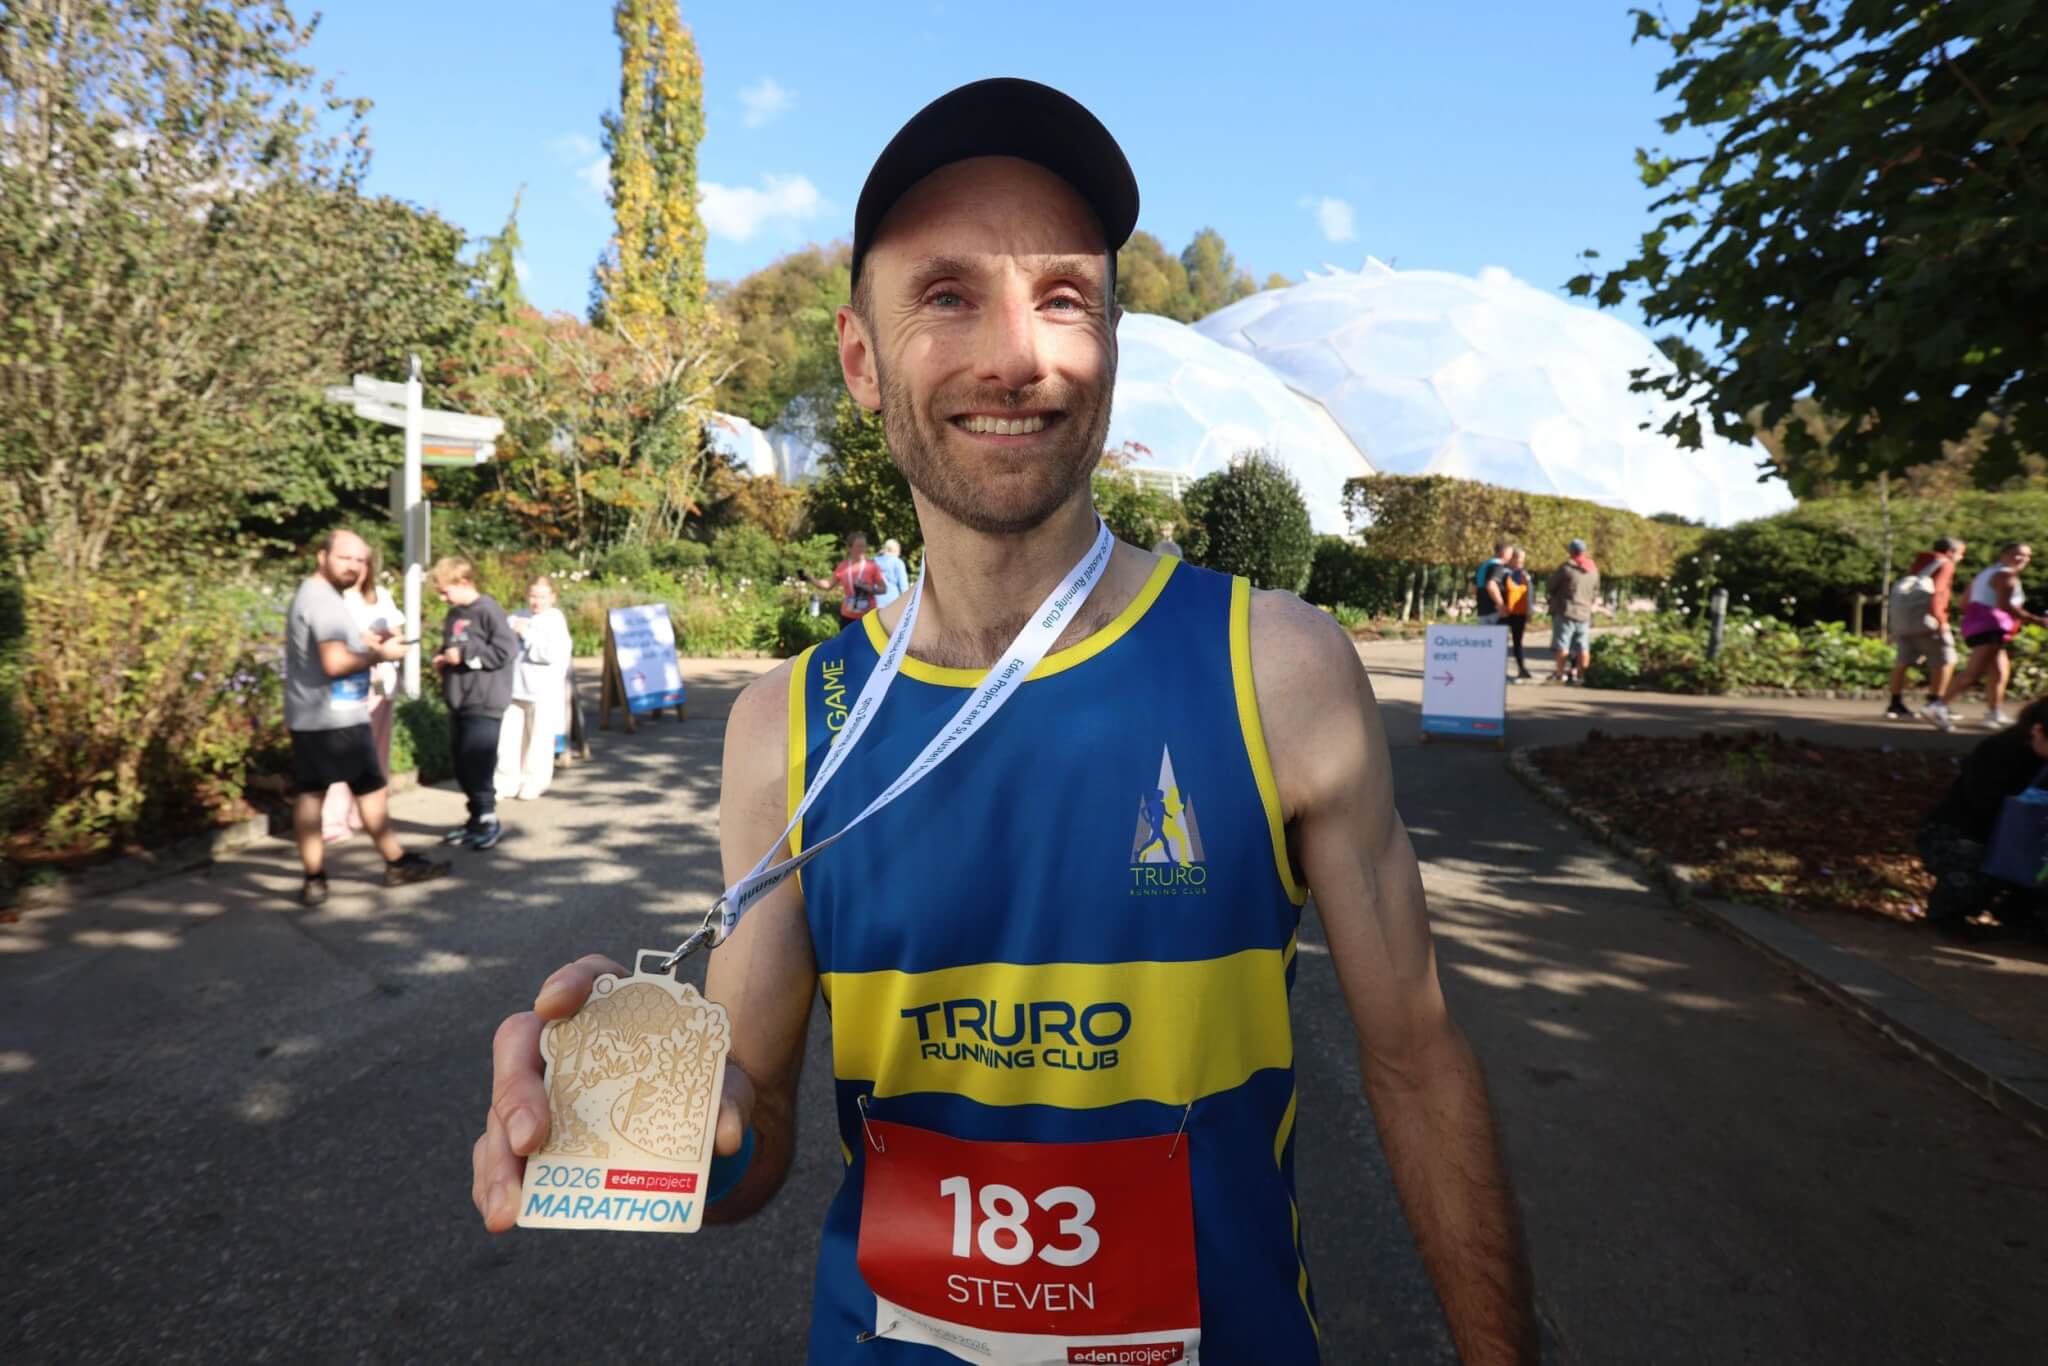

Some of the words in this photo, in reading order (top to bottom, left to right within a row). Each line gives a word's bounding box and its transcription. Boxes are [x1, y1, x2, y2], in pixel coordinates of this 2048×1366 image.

[1055, 575, 1087, 612] Running
[1042, 609, 1060, 629] Club
[1434, 635, 1492, 648] Quickest
[1433, 651, 1457, 661] exit
[1001, 658, 1024, 679] Eden
[980, 679, 1007, 709] Project
[963, 709, 980, 726] and
[952, 726, 967, 736] St
[1130, 866, 1206, 886] TRURO
[900, 998, 1131, 1046] TRURO
[921, 1041, 1035, 1069] RUNNING
[1042, 1048, 1119, 1071] CLUB
[534, 1164, 601, 1189] 2026
[611, 1173, 645, 1185] eden
[645, 1175, 692, 1189] project
[525, 1193, 693, 1223] MARATHON
[940, 1175, 1100, 1267] 183
[947, 1274, 1095, 1311] STEVEN
[1074, 1350, 1117, 1363] eden
[1120, 1347, 1177, 1365] project
